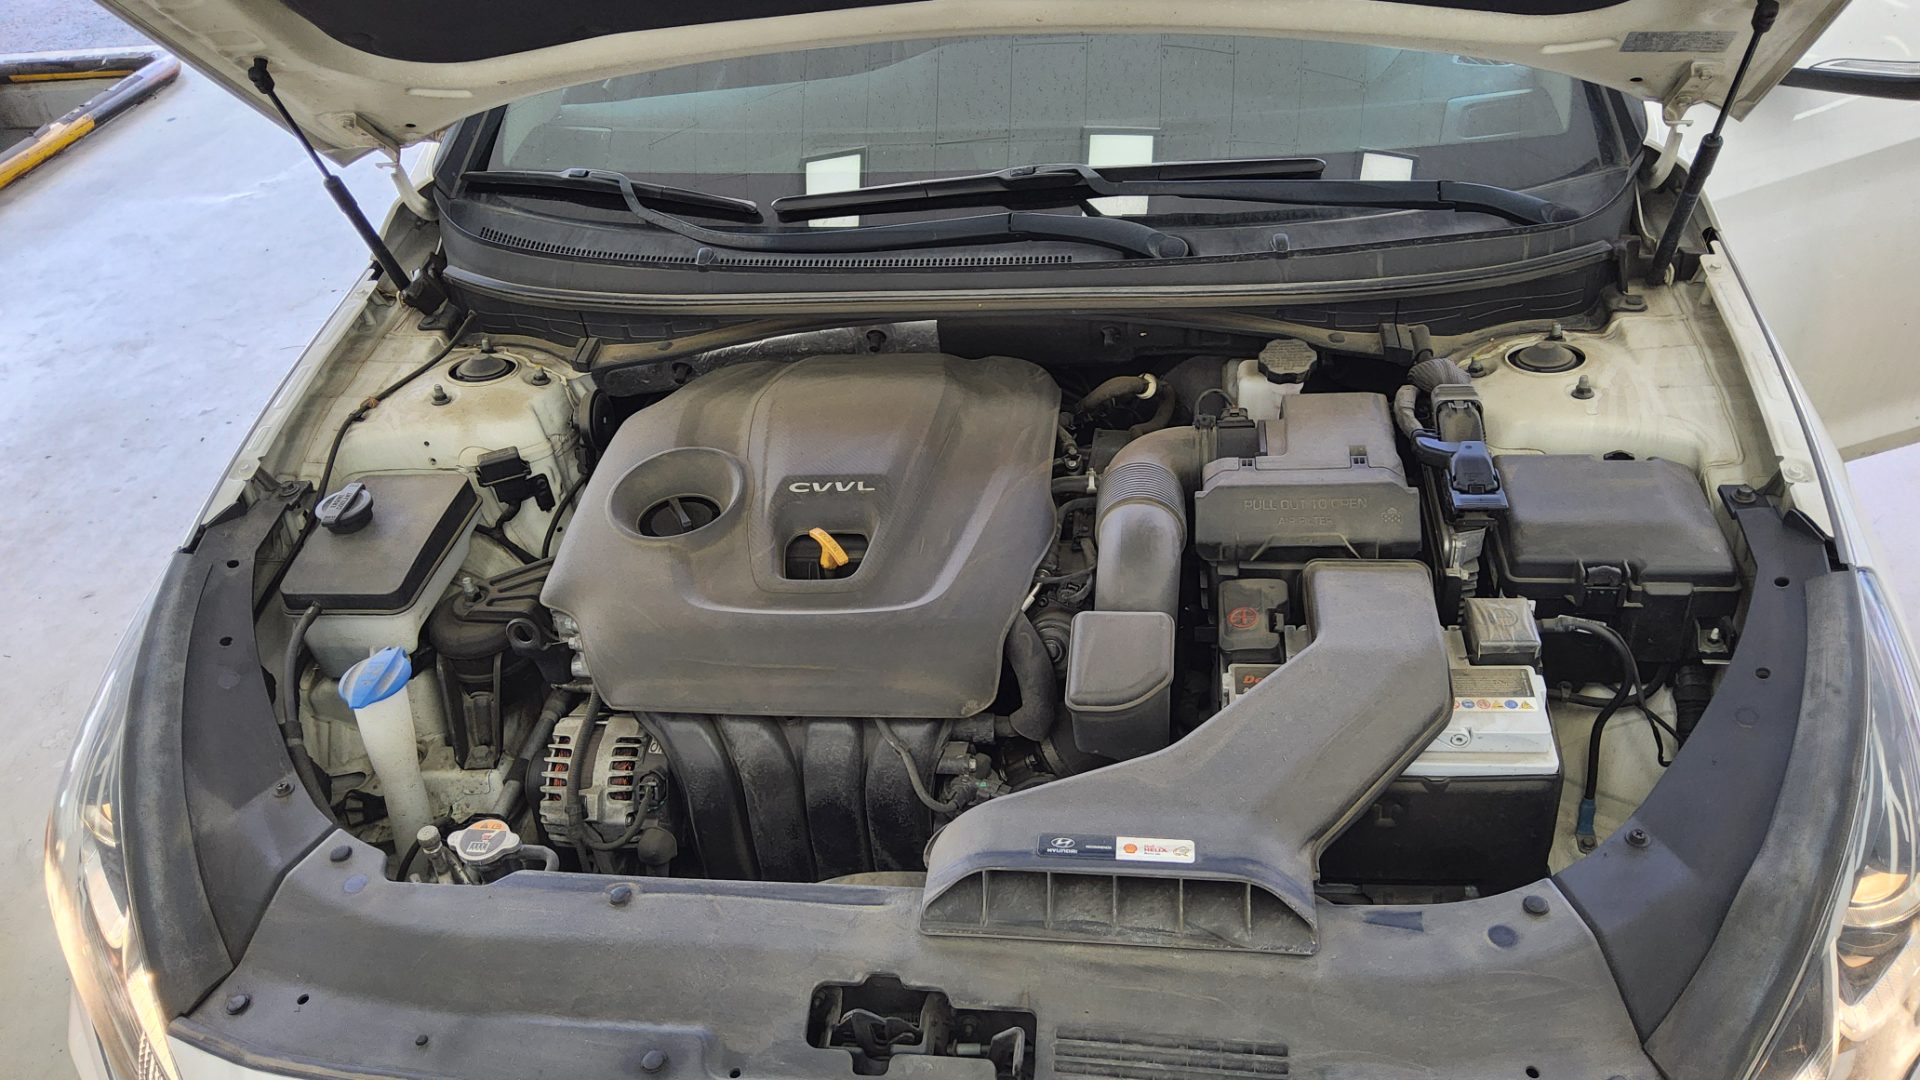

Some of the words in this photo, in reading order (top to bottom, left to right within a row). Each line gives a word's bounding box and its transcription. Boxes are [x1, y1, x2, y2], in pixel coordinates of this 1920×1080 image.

[789, 481, 875, 493] CVVL
[1244, 499, 1277, 511] PULL
[1280, 499, 1306, 510] OUT
[1311, 499, 1328, 510] TO
